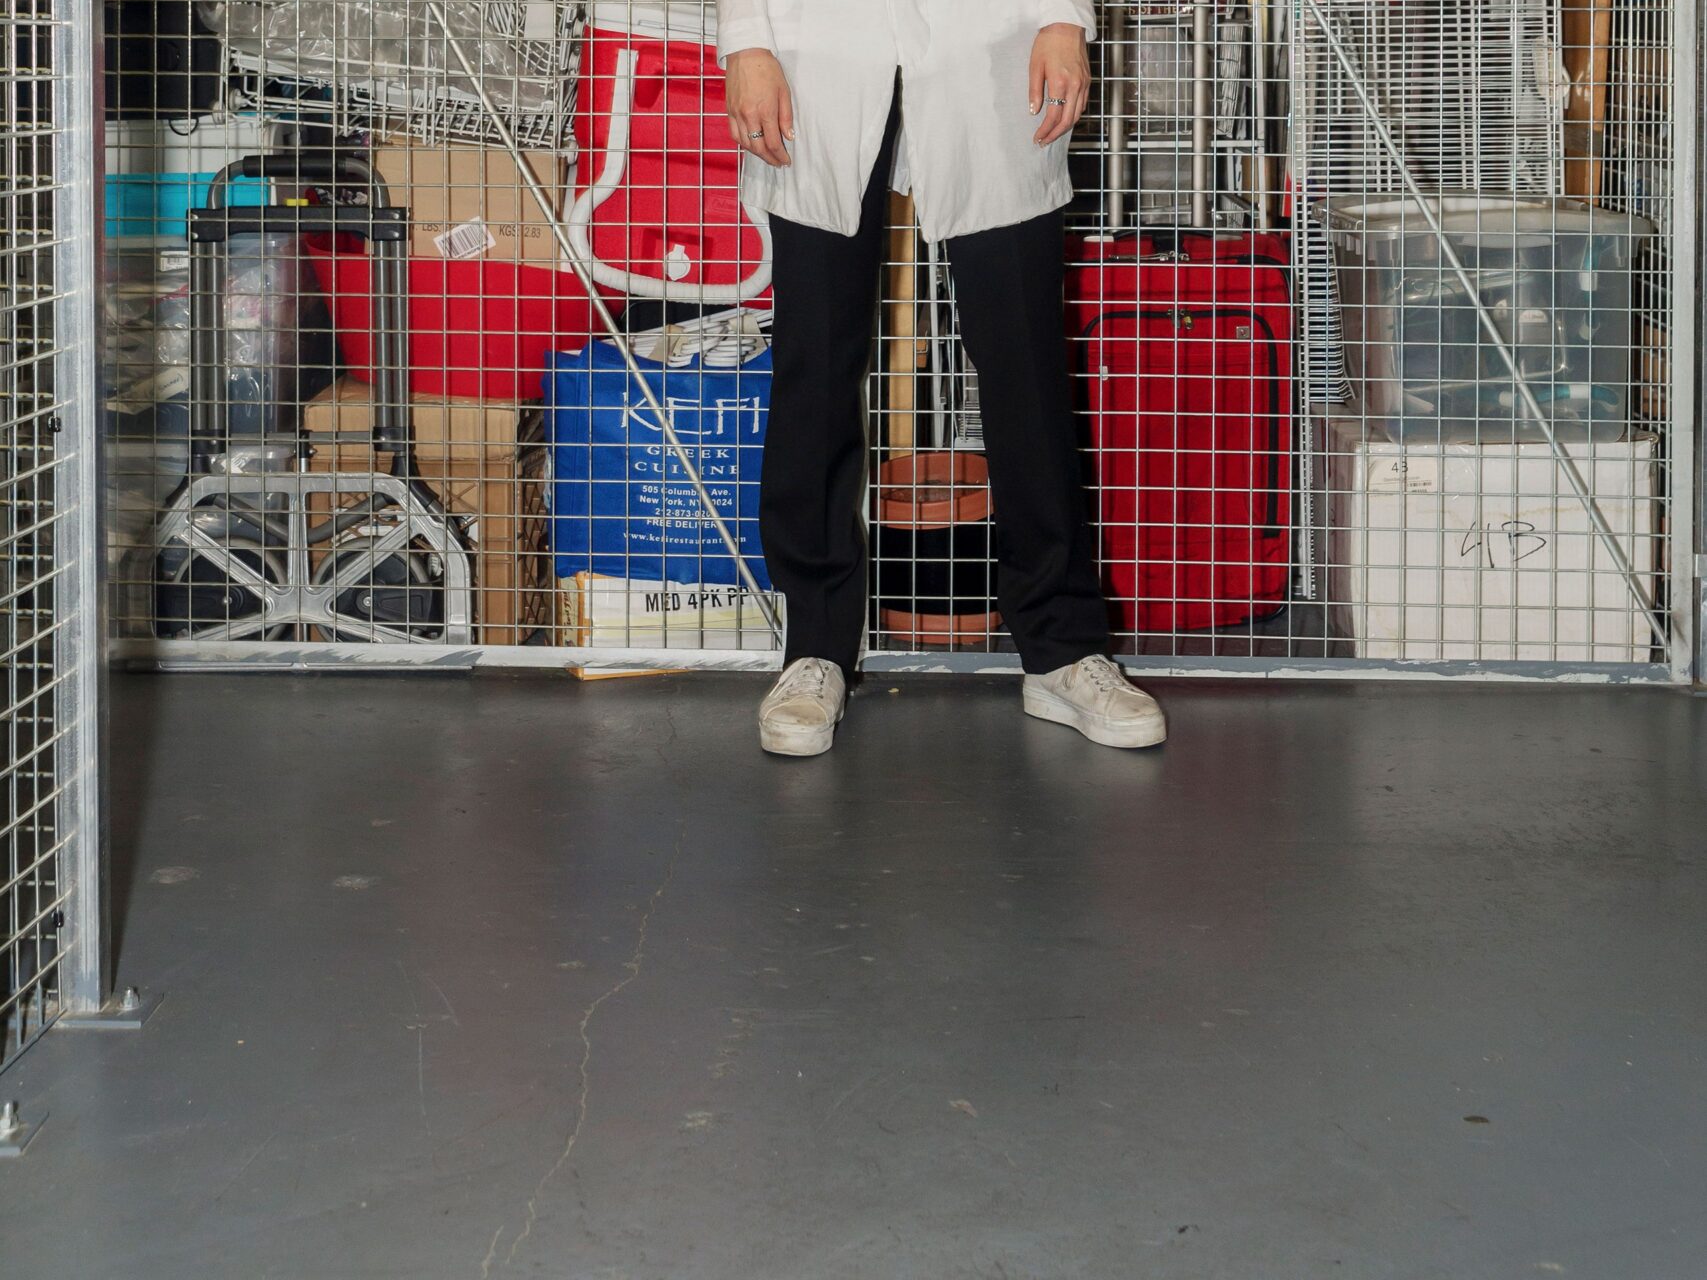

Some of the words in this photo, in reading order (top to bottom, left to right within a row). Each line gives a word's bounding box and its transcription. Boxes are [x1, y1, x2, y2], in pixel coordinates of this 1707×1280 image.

[620, 391, 760, 435] KEFI
[646, 446, 730, 459] GREEK
[634, 461, 740, 475] CUIINE
[642, 484, 659, 494] 505
[661, 486, 704, 497] Columb
[711, 488, 731, 496] Ave.
[639, 495, 659, 504] New
[709, 498, 733, 507] 024
[675, 520, 719, 529] DELIVER
[623, 531, 747, 545] www.keirestaurant.m
[1460, 520, 1547, 568] 4B
[645, 592, 681, 613] MED
[687, 588, 722, 609] 4PK
